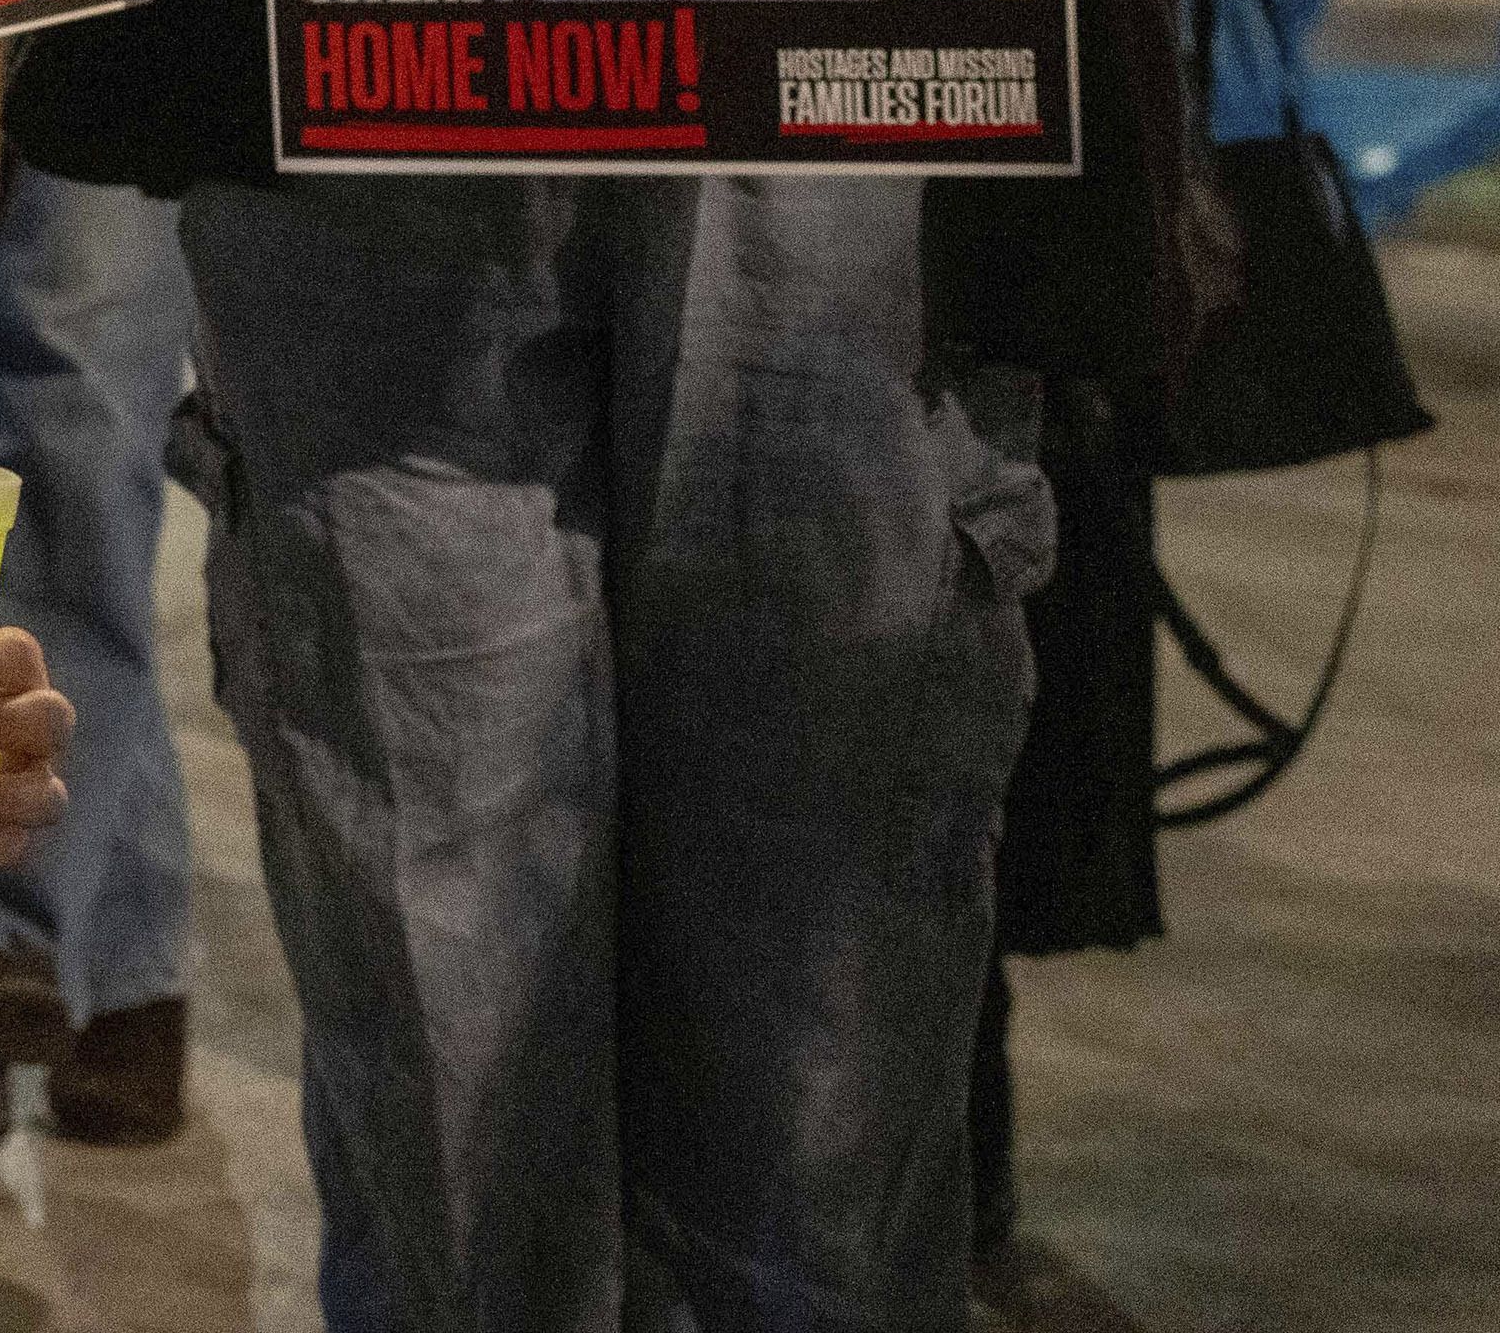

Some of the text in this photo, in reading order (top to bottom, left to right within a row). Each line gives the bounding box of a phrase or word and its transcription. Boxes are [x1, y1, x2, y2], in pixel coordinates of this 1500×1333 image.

[304, 8, 699, 111] HOME NOW!
[777, 49, 1034, 80] HOSTAGES AND MISSING
[779, 80, 1036, 126] FAMILIES FORUM
